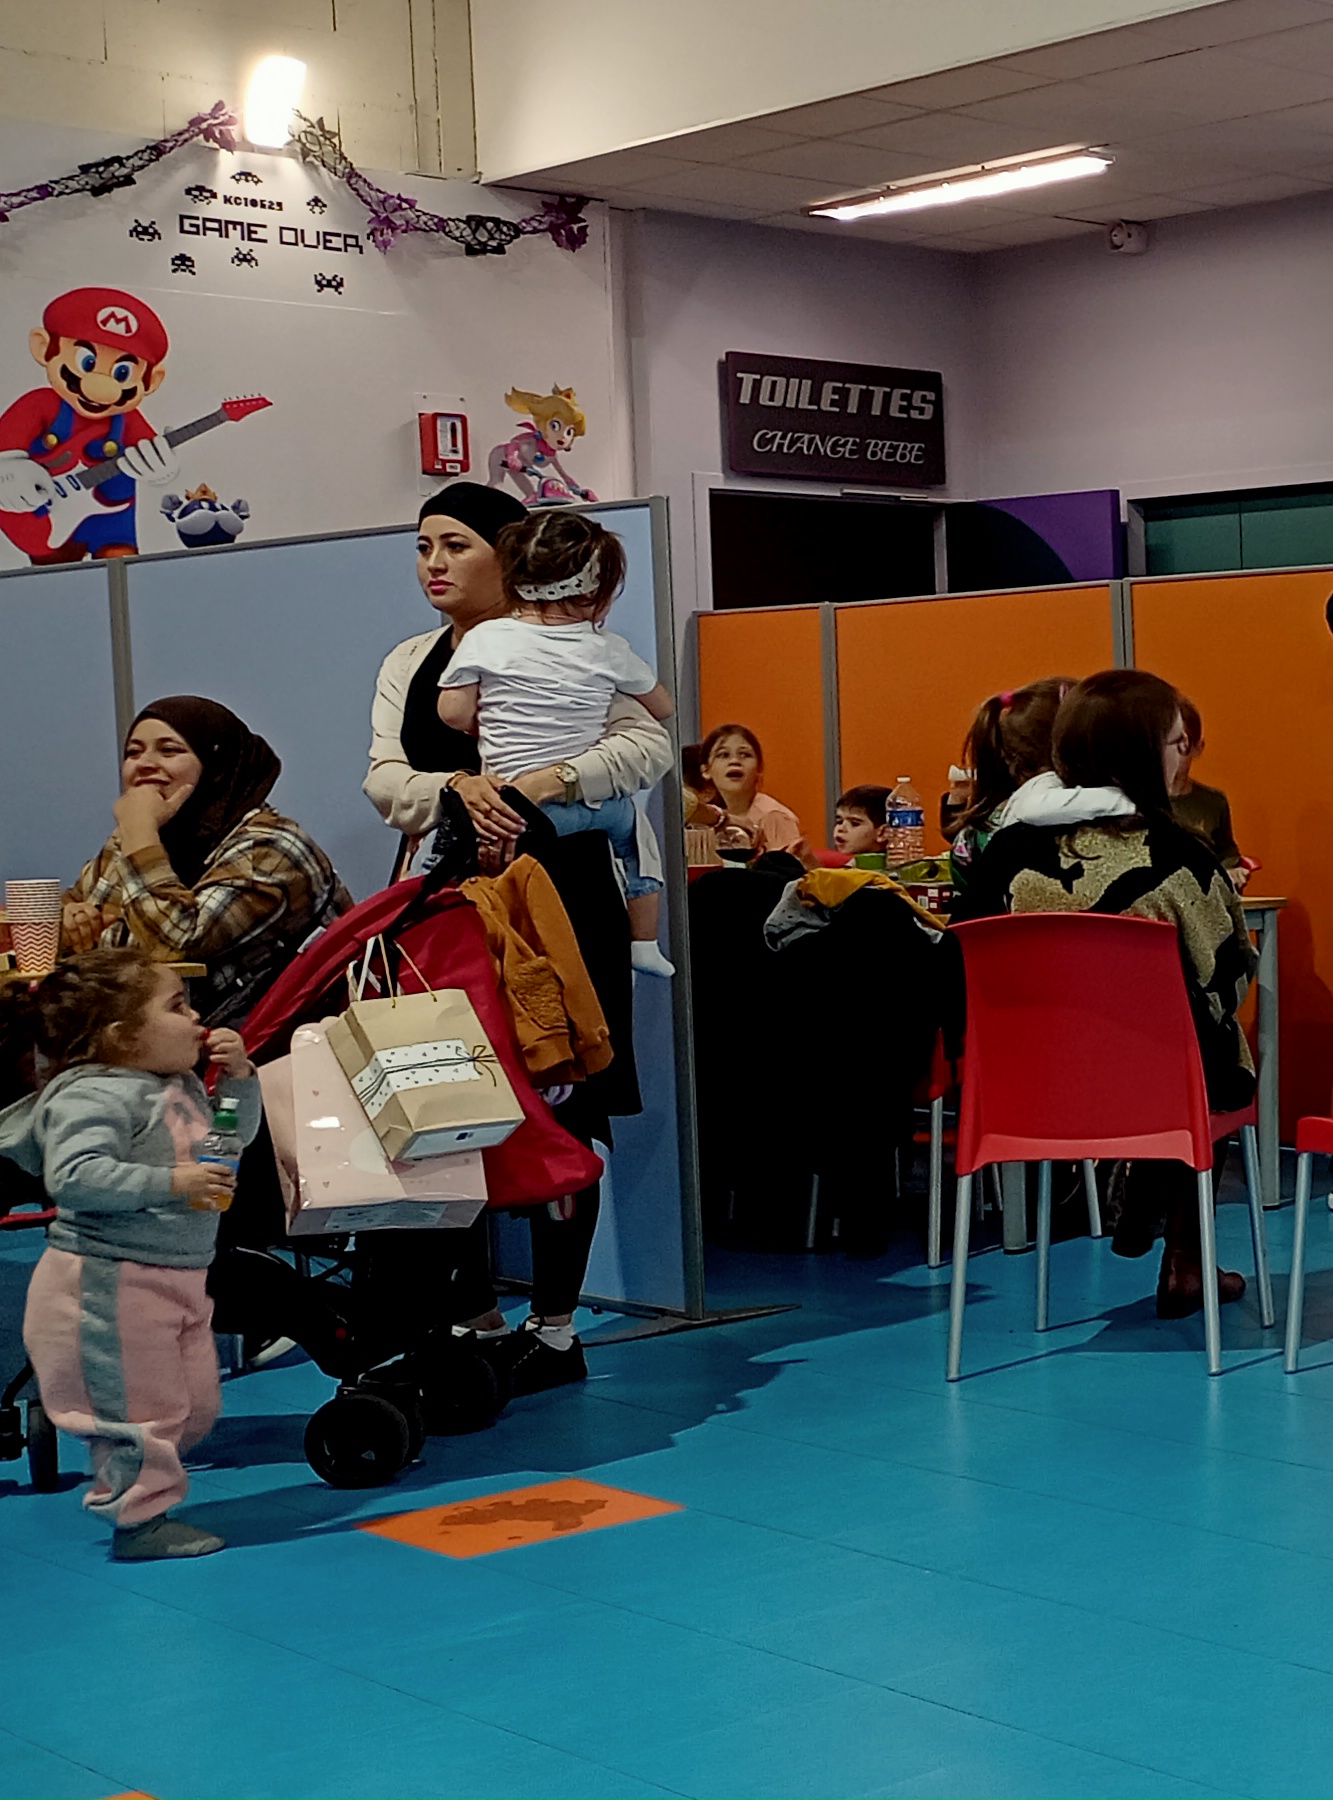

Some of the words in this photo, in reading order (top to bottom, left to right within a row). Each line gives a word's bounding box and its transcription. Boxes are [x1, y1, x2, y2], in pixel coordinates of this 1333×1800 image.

[178, 214, 268, 243] GAME
[279, 226, 364, 254] OVER
[100, 310, 132, 334] M
[736, 372, 936, 420] TOILETTES
[752, 429, 860, 459] CHANGE
[865, 439, 926, 464] BEBE
